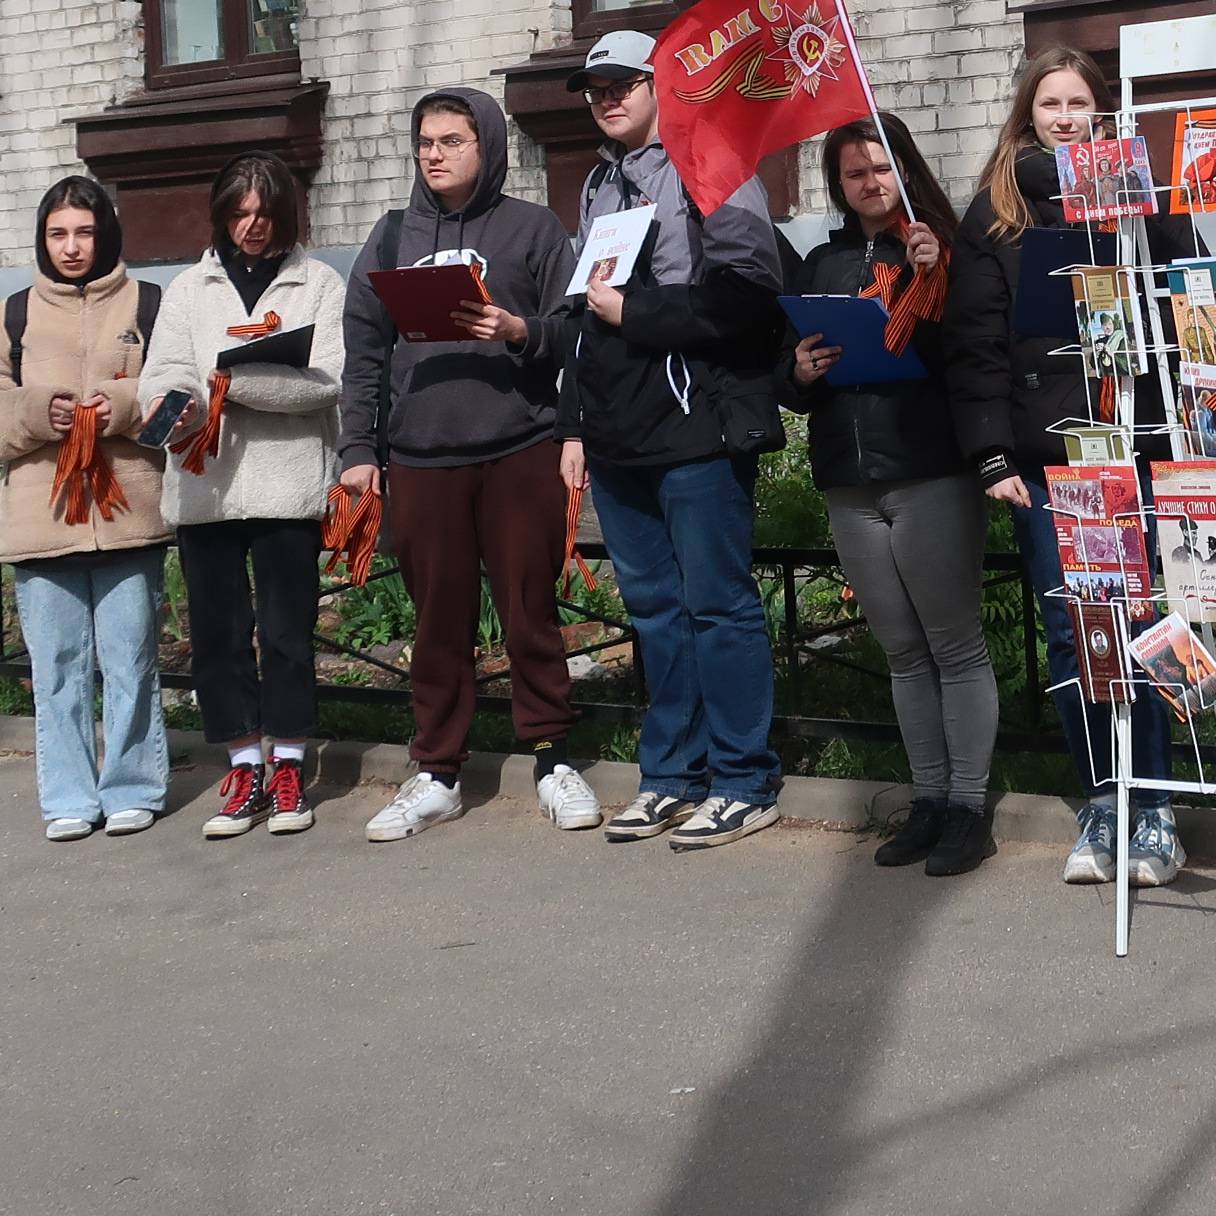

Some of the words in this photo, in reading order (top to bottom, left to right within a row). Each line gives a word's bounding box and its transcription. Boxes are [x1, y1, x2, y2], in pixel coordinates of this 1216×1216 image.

[1075, 210, 1082, 219] С
[1157, 501, 1185, 514] ЛУЧШИЕ
[1187, 501, 1208, 514] СТИХИ
[1210, 501, 1216, 514] О
